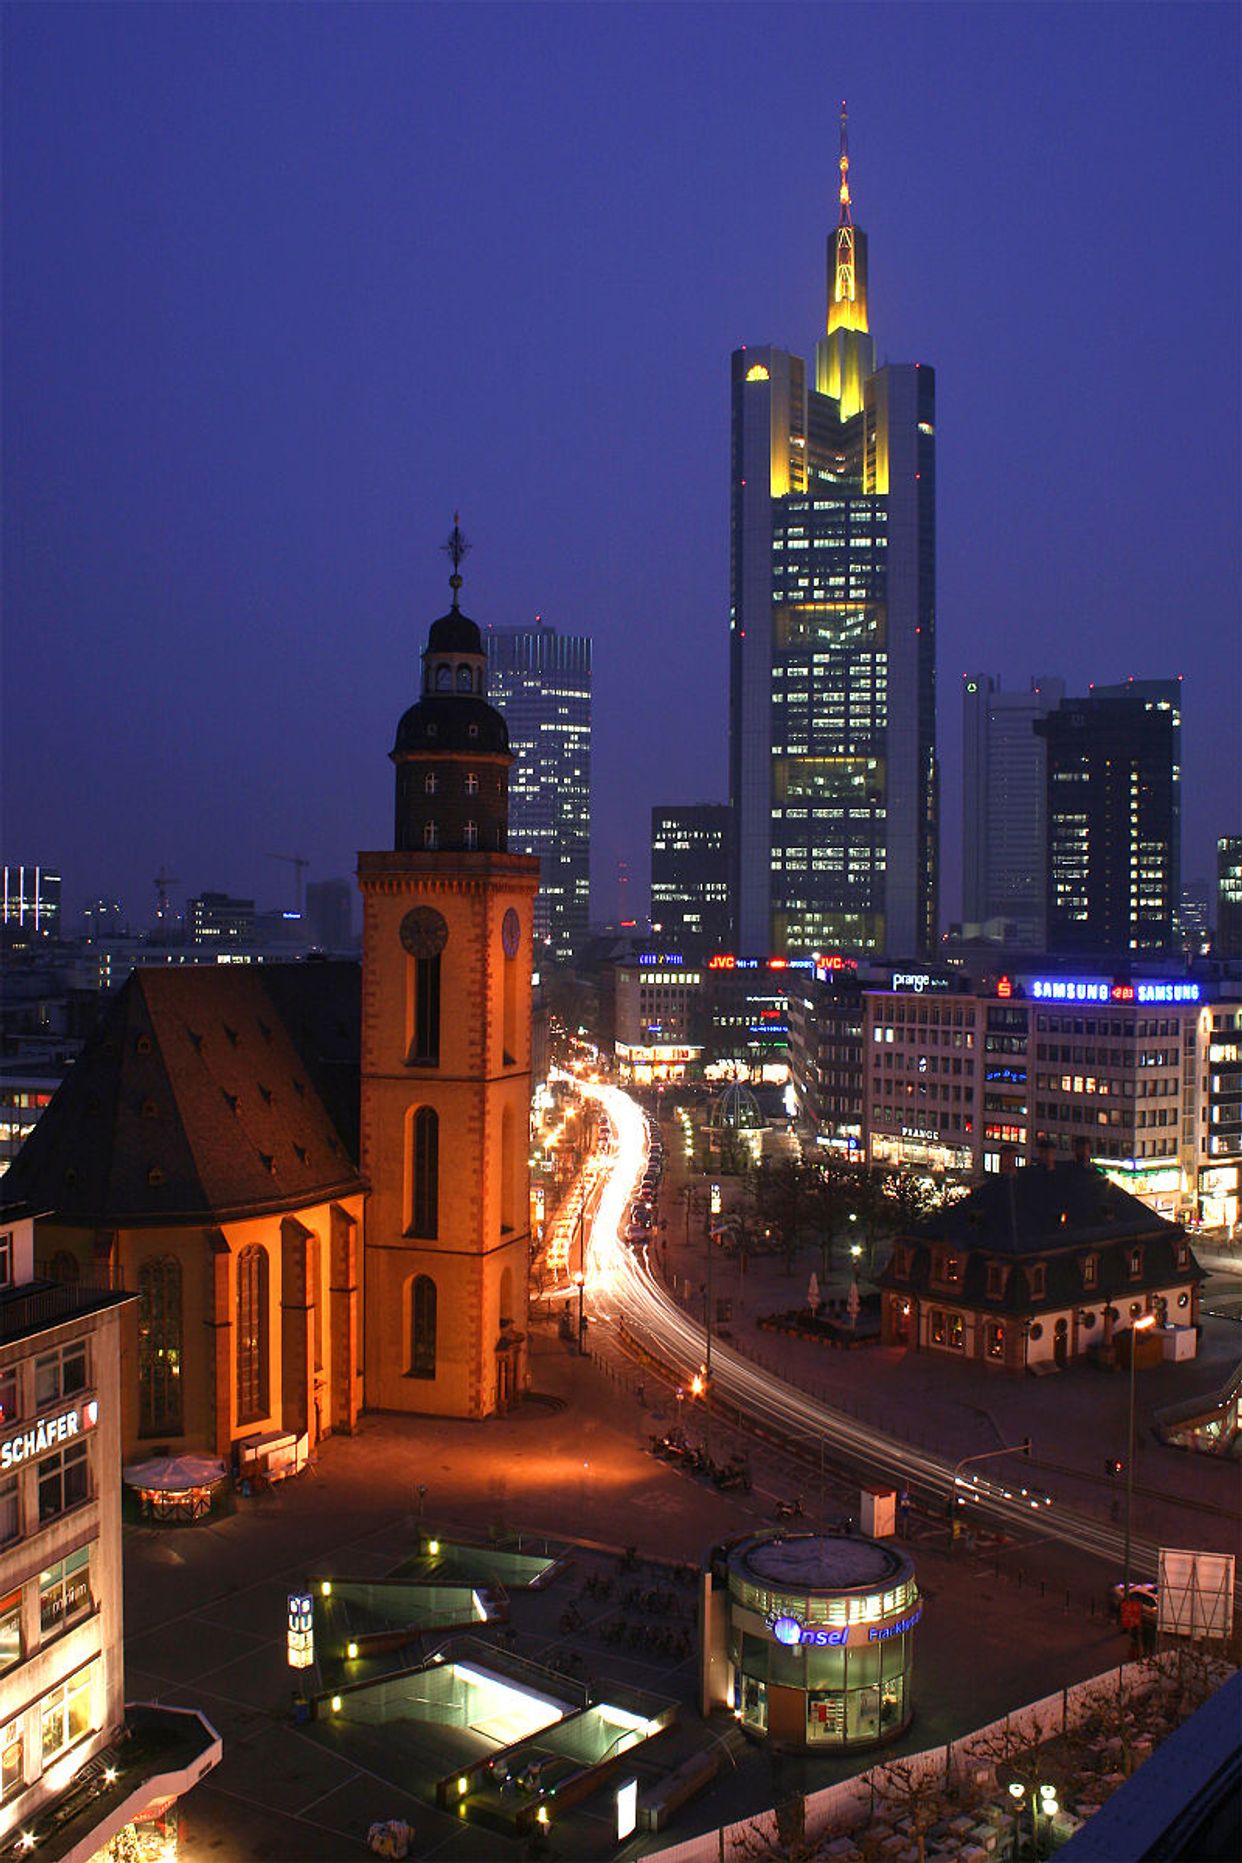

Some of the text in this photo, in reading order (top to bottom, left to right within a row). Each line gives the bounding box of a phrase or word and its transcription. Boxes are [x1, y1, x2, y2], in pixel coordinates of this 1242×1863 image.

[708, 954, 735, 969] JVC
[816, 956, 842, 969] JVC
[893, 974, 930, 992] prange
[1033, 981, 1108, 1001] SAMSUNG
[1138, 984, 1199, 1002] SAMSUNG
[1, 1411, 79, 1469] SCHÄFER
